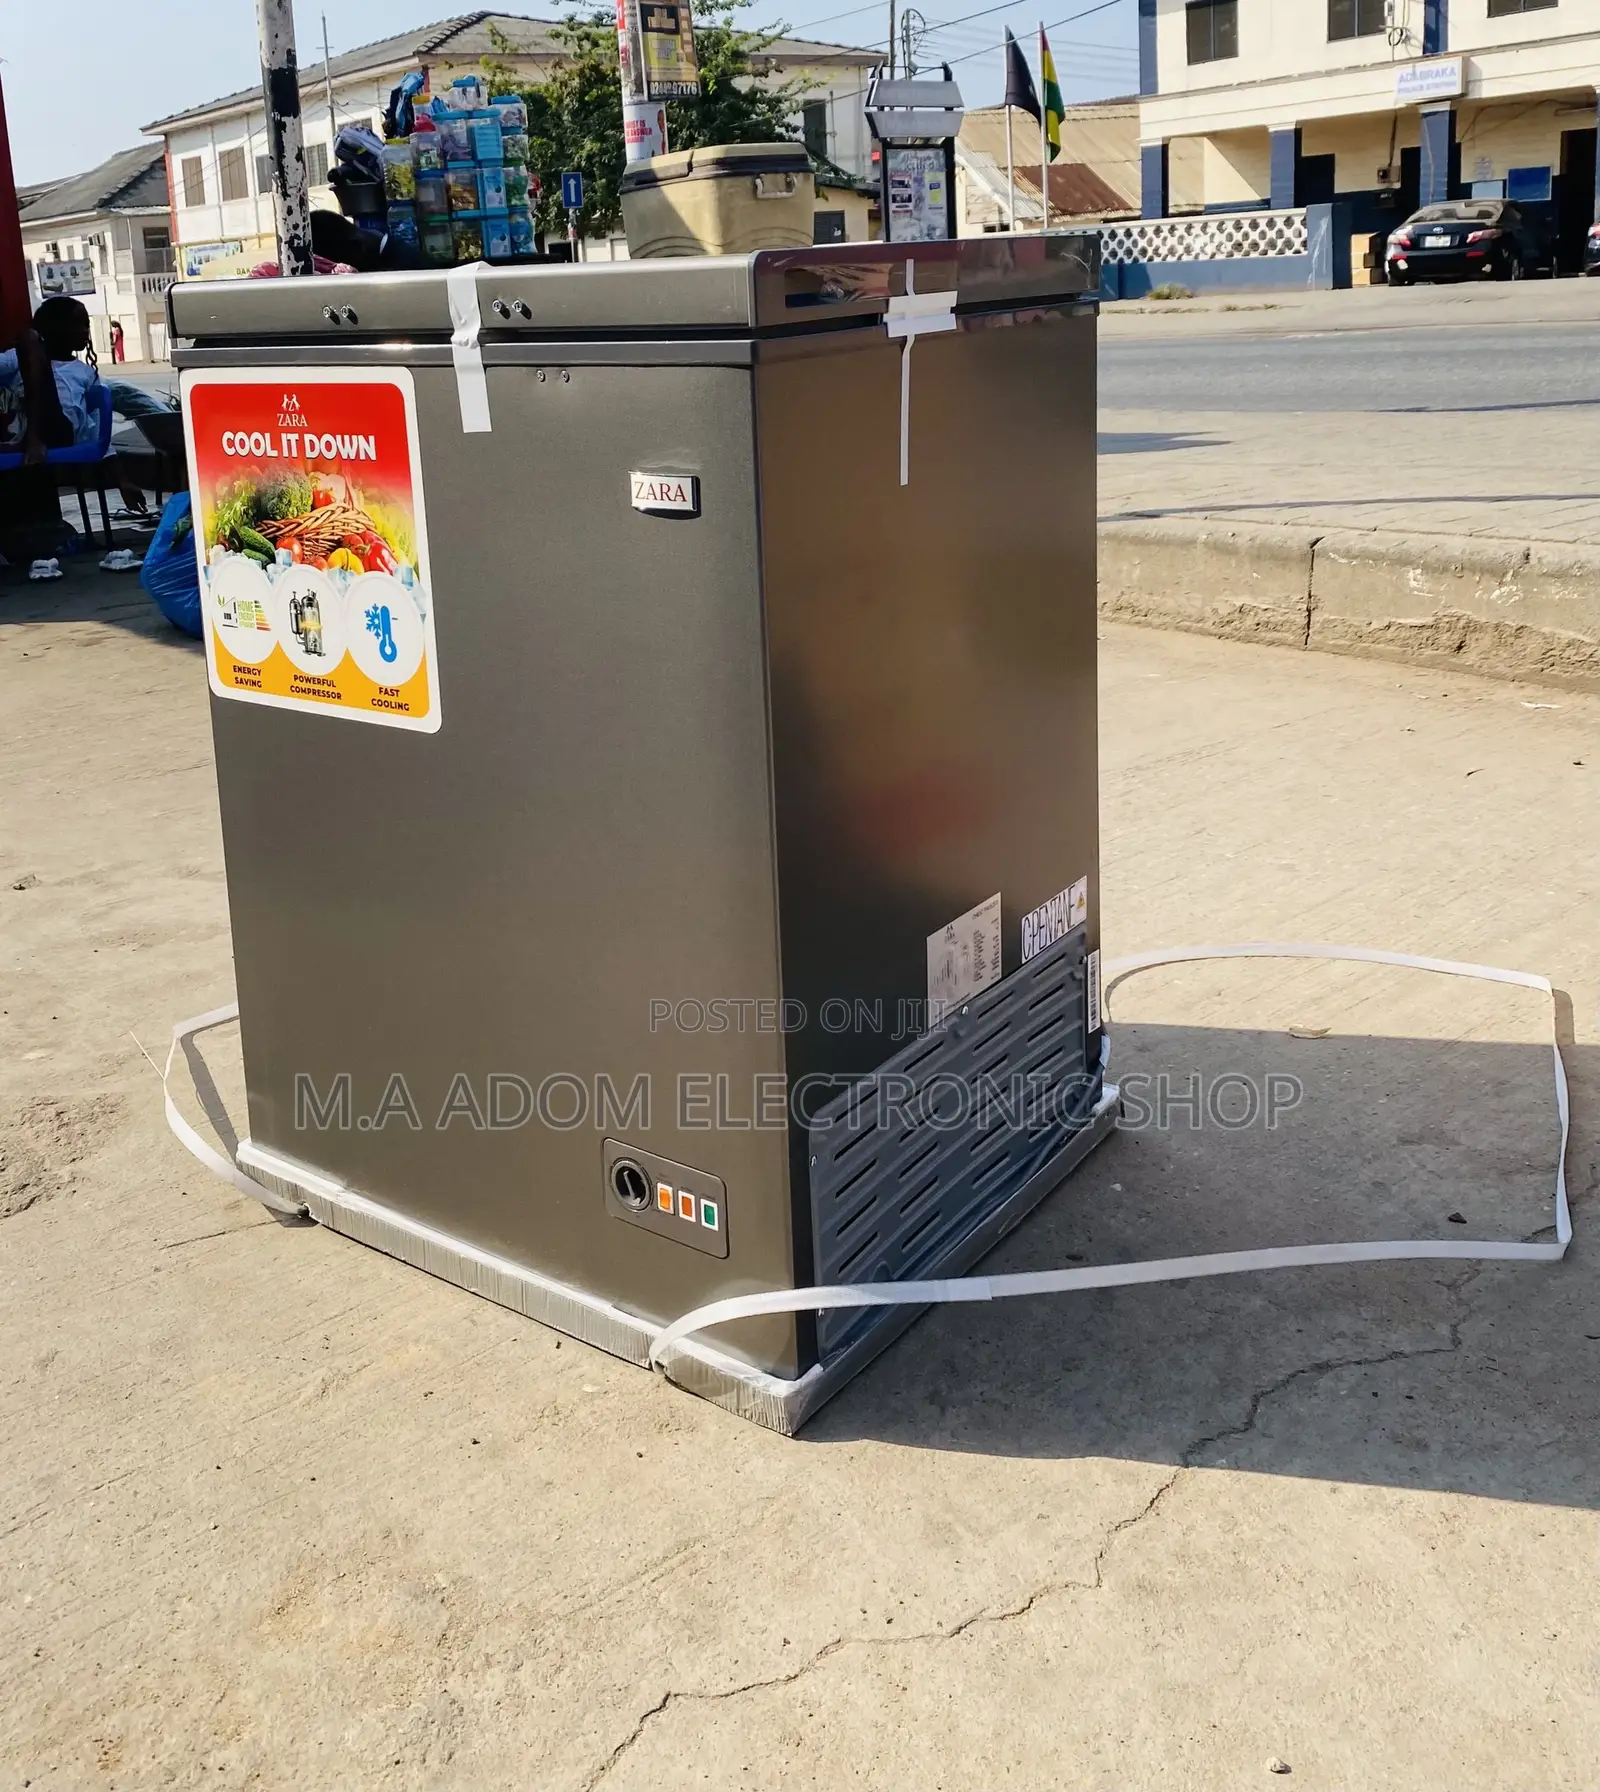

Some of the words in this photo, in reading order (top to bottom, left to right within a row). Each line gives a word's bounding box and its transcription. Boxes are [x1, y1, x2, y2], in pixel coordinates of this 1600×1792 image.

[277, 413, 308, 427] ZARA
[221, 431, 278, 457] COOL
[280, 432, 299, 458] IT
[303, 433, 377, 461] DOWN
[634, 481, 687, 503] ZARA
[233, 665, 261, 677] ENERGY
[234, 676, 262, 688] SAVING
[293, 674, 336, 688] POWERFUL
[290, 685, 342, 700] COMPRESSOR
[378, 686, 400, 698] FAST
[371, 698, 410, 712] COOLING
